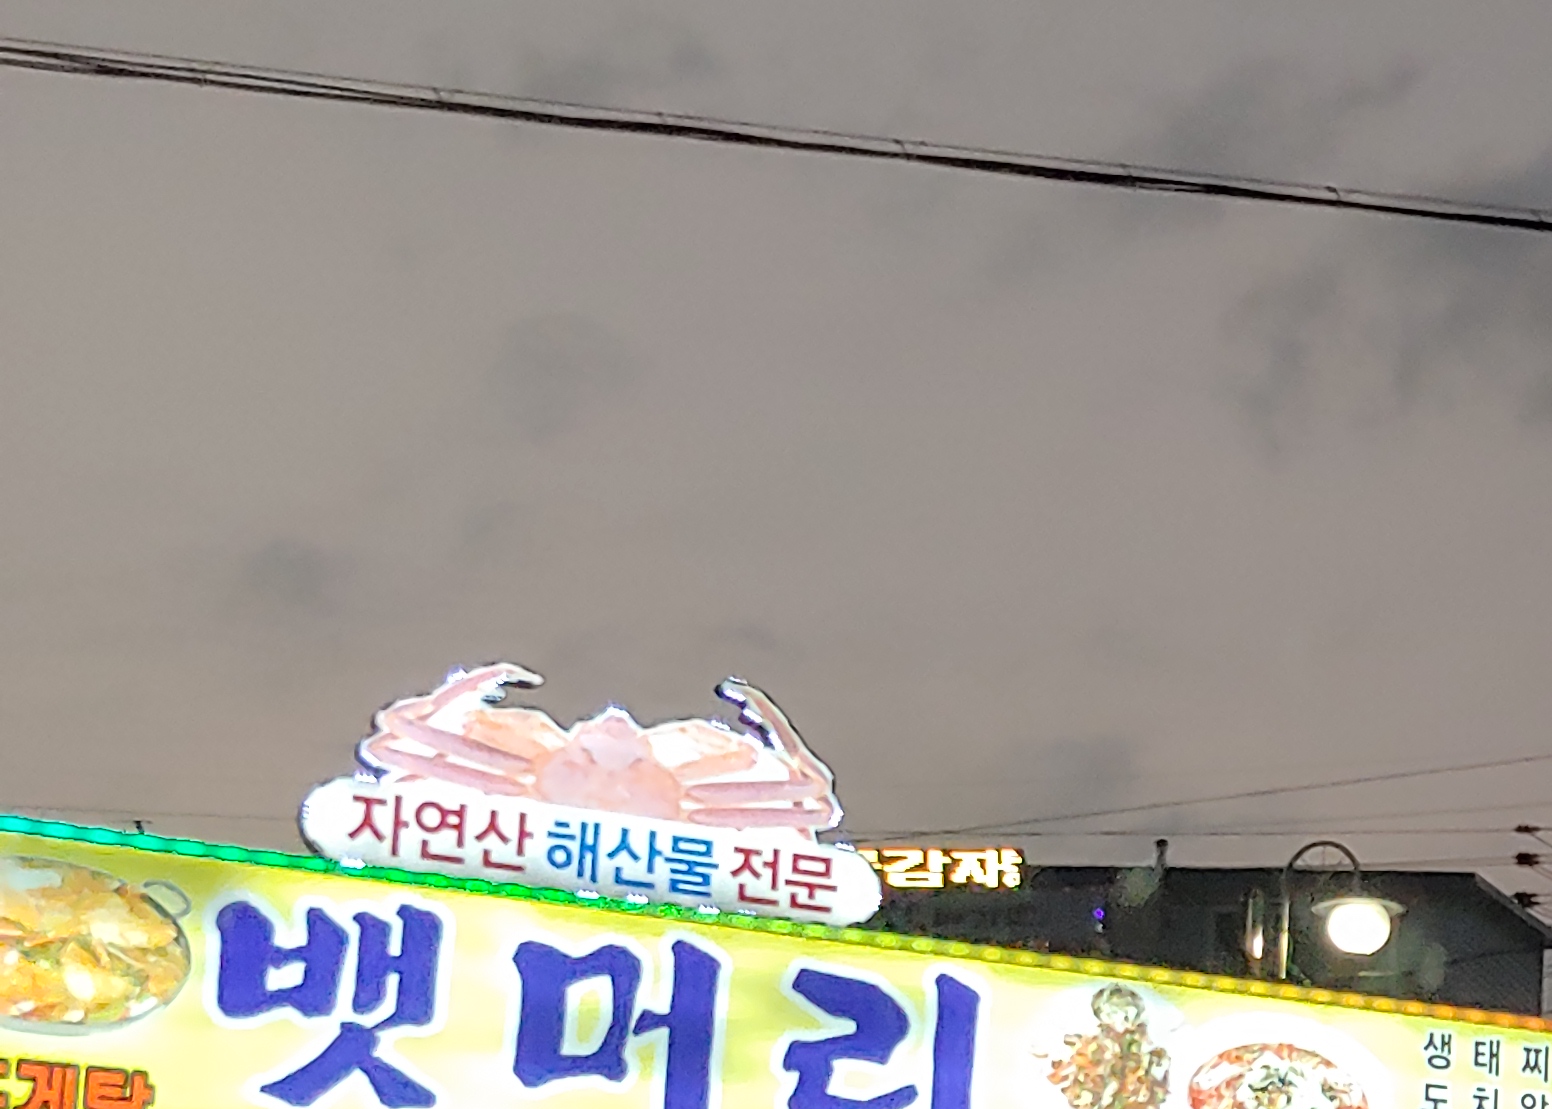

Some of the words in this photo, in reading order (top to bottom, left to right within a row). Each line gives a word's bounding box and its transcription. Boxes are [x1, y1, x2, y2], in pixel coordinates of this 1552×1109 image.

[348, 794, 533, 871] 자연산
[545, 819, 720, 898] 해산물
[730, 846, 838, 913] 전문
